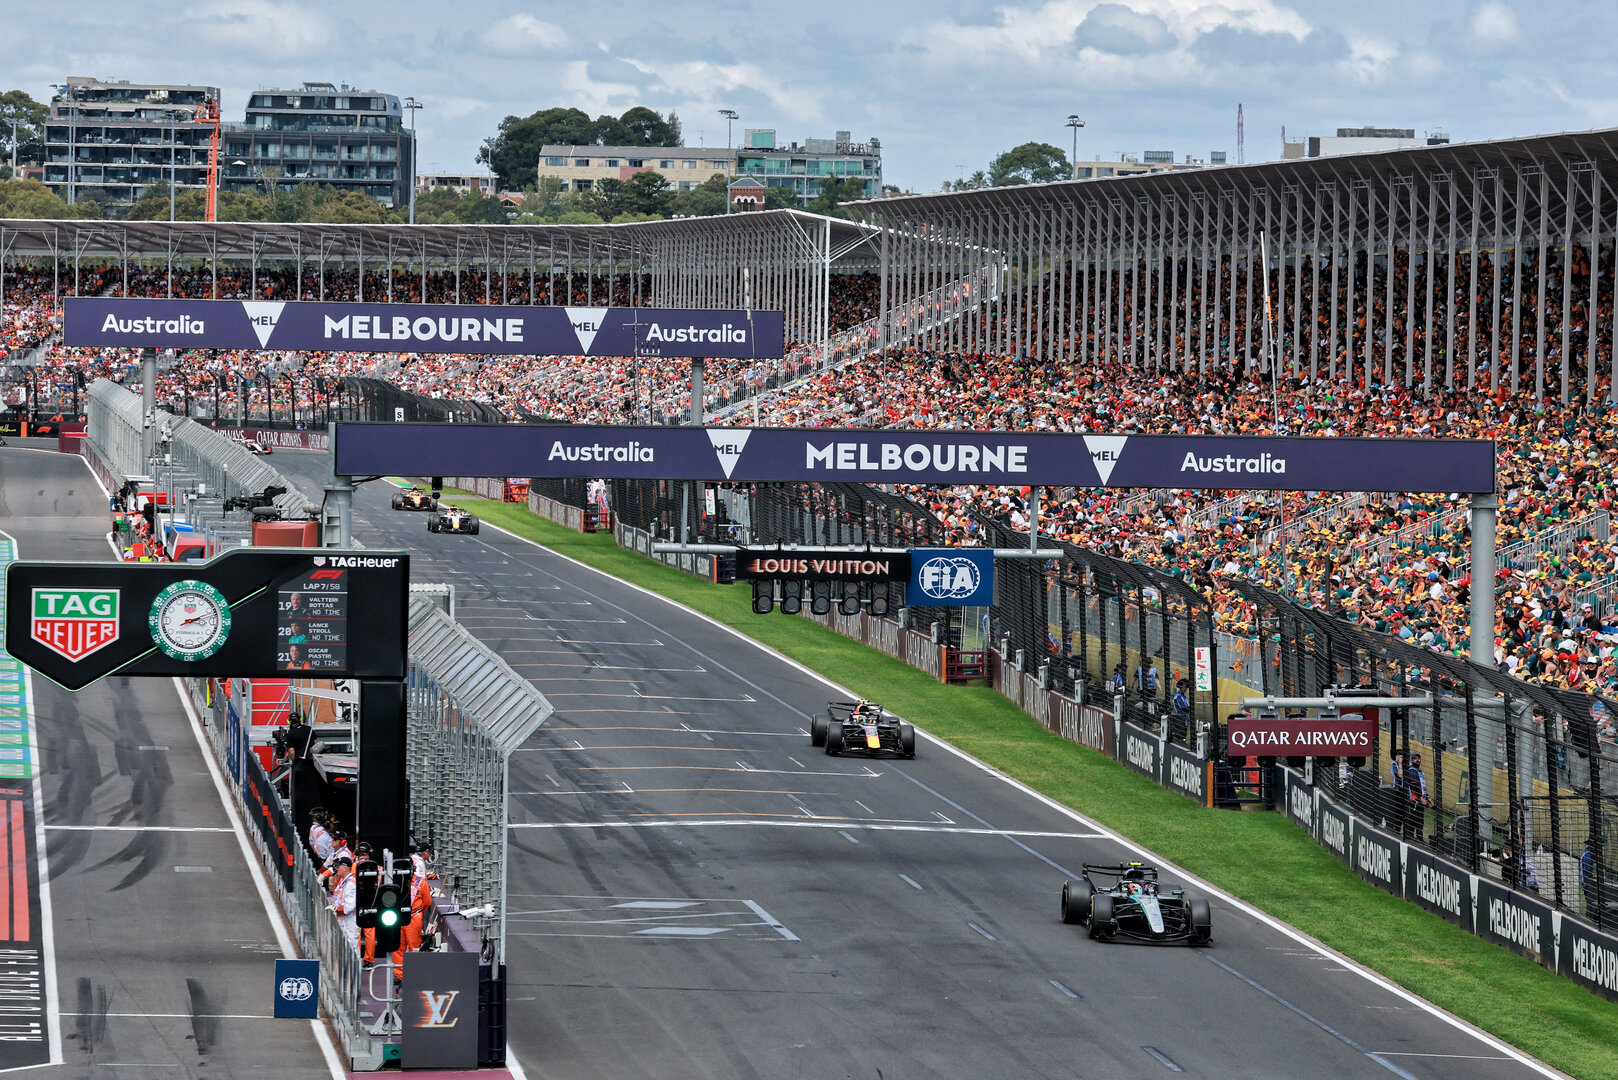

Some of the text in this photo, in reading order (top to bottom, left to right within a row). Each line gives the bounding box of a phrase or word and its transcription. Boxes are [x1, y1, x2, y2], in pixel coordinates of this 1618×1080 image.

[102, 314, 204, 335] Australia
[250, 316, 277, 325] MEL
[325, 315, 524, 342] MELBOURNE
[573, 322, 599, 331] MEL
[646, 323, 746, 344] Australia
[256, 430, 302, 447] QATAR AIRWAYS
[715, 444, 741, 454] MEL
[548, 441, 653, 462] Australia
[807, 442, 1028, 473] MELBOURNE
[1091, 451, 1118, 461] MEL
[1181, 452, 1285, 473] Australia
[756, 559, 889, 575] LOUIS VUITTON
[204, 585, 216, 594] 05
[40, 595, 111, 616] TAG
[278, 602, 292, 610] 19
[37, 622, 113, 656] HEUER
[278, 627, 292, 636] 20
[277, 653, 291, 662] 21
[1232, 731, 1369, 748] QATAR AIRWAYS
[1127, 734, 1153, 774] MELBOURNE
[1170, 755, 1201, 796] MELBOURNE
[1358, 834, 1391, 883] MELBOURNE
[1416, 861, 1461, 916] MELBOURNE
[1489, 896, 1541, 954] MELBOURNE
